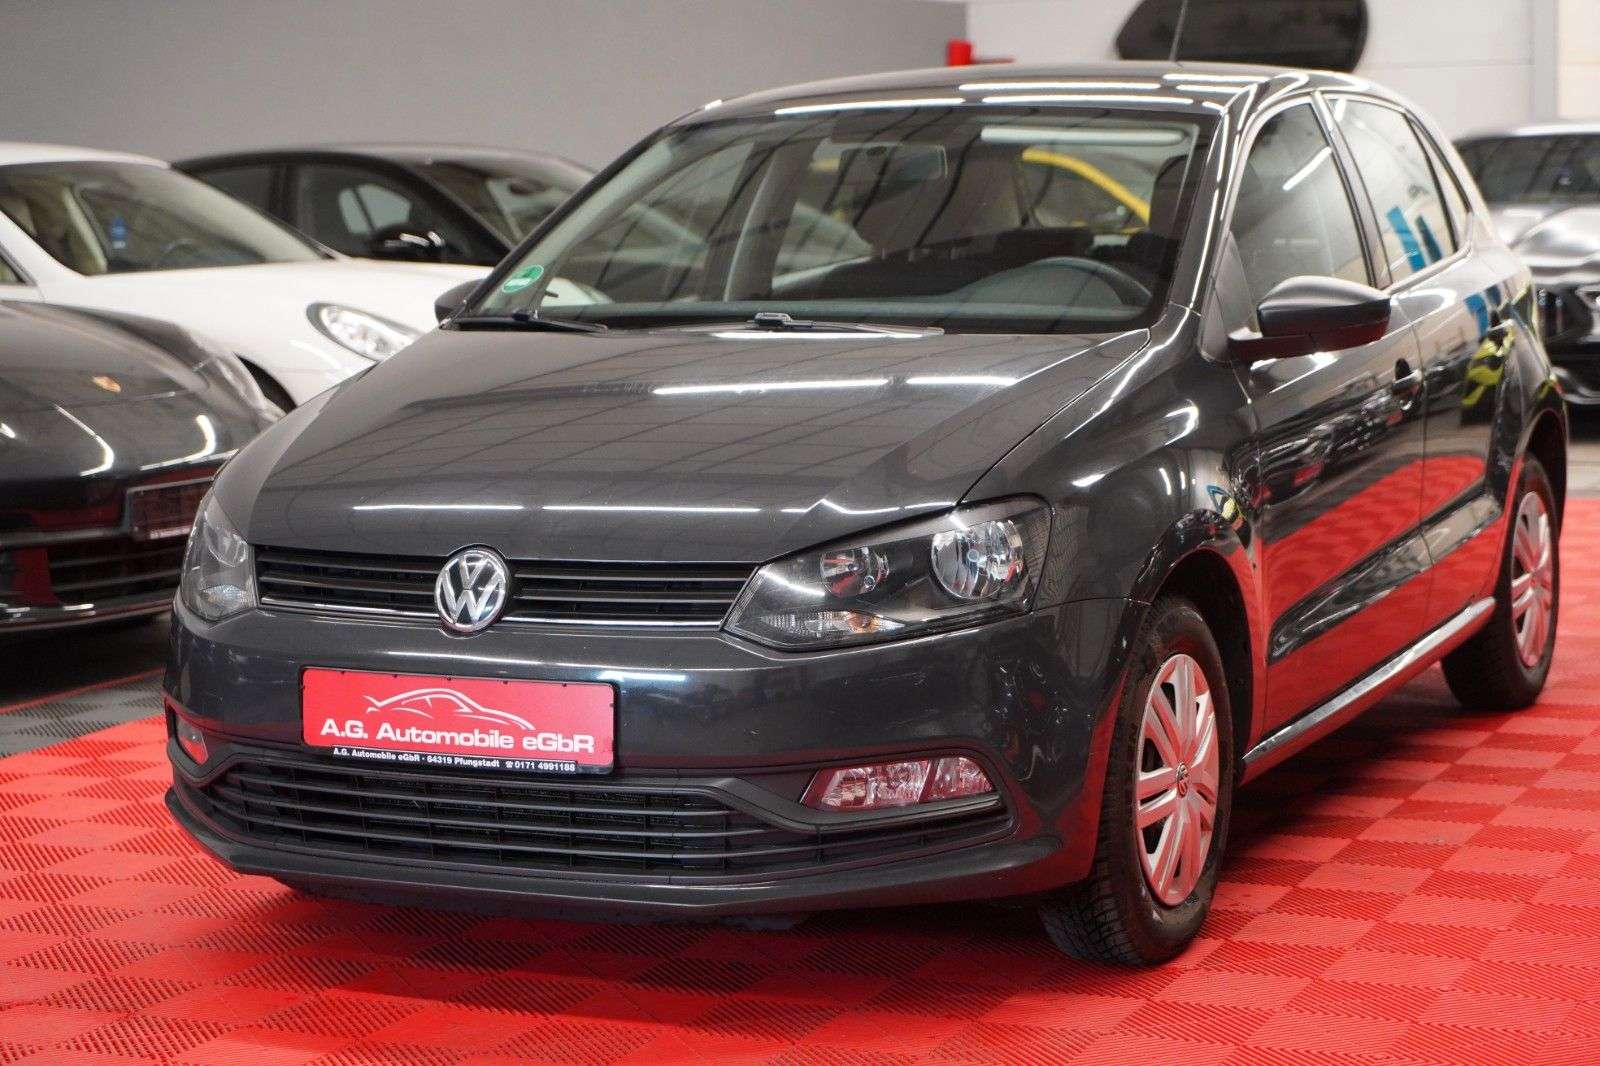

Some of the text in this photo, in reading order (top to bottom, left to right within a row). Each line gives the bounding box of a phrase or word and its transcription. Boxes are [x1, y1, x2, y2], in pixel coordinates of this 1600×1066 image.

[437, 550, 507, 629] VW
[320, 718, 594, 753] A.G. Automobile eGbR
[333, 747, 350, 756] A.G.
[352, 749, 396, 760] Automobile
[398, 754, 421, 762] eGbR
[427, 755, 452, 764] 64319
[454, 757, 500, 768] Pfungstadt
[514, 760, 535, 770] 0171
